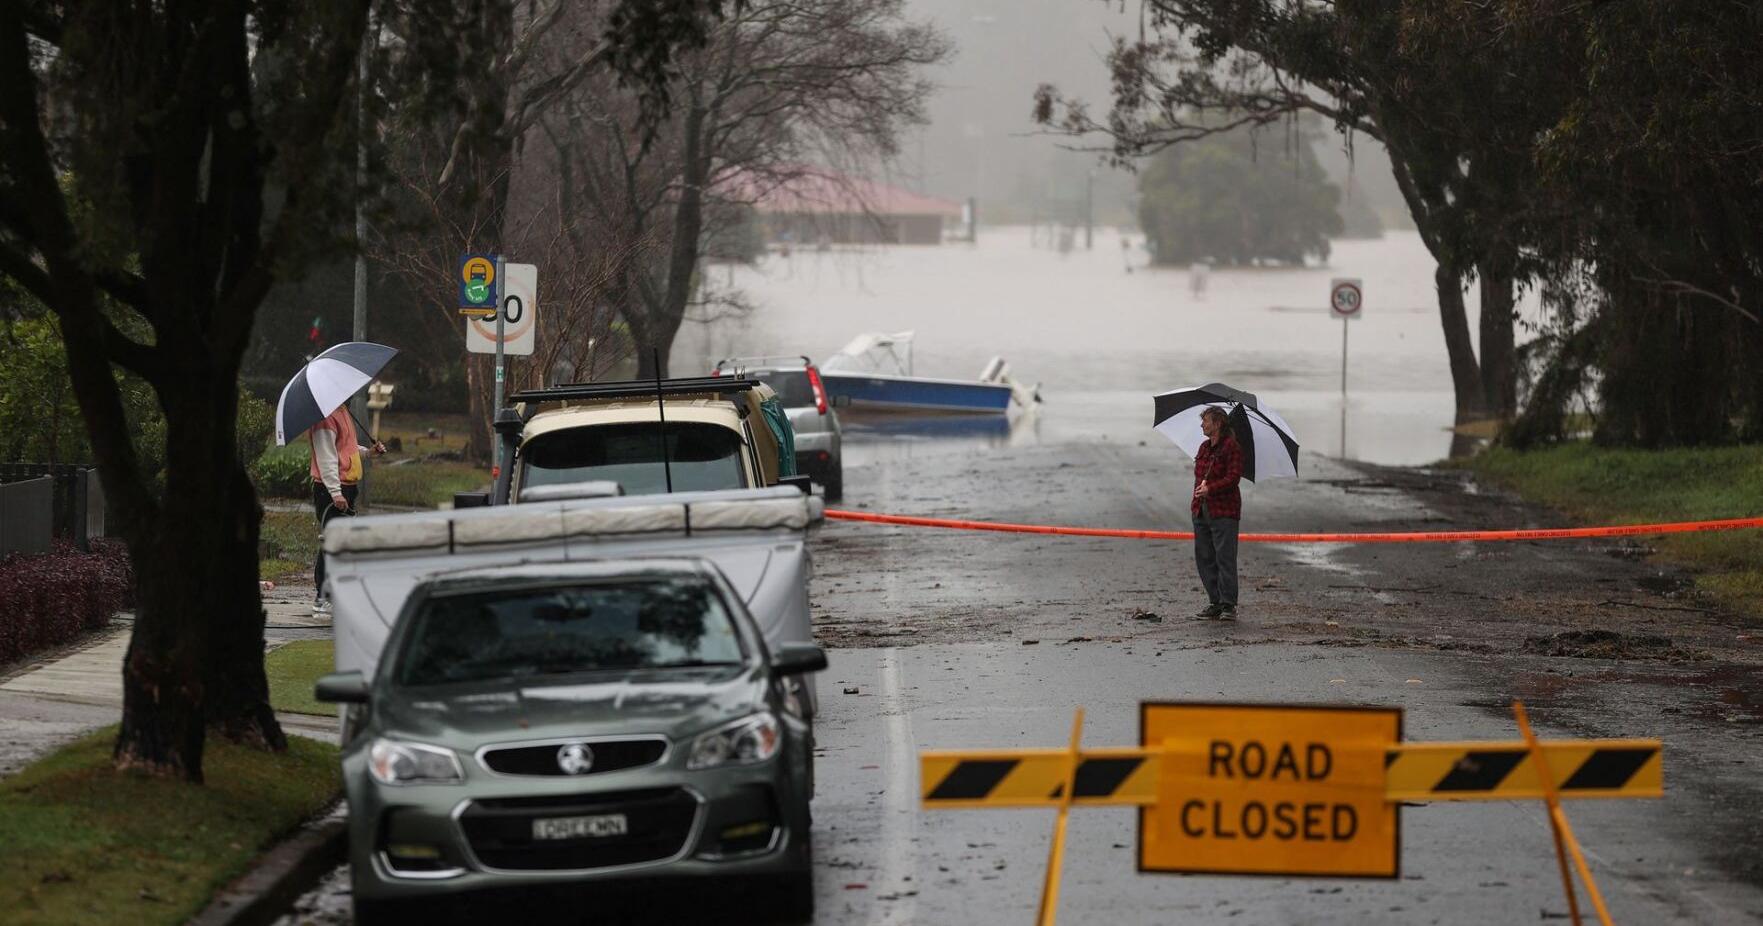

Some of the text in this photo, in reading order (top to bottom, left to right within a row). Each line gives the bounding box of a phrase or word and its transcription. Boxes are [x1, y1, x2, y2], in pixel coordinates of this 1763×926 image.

[482, 295, 522, 323] 0
[1337, 290, 1358, 306] 50
[1208, 740, 1332, 779] ROAD
[1181, 799, 1358, 841] CLOSED
